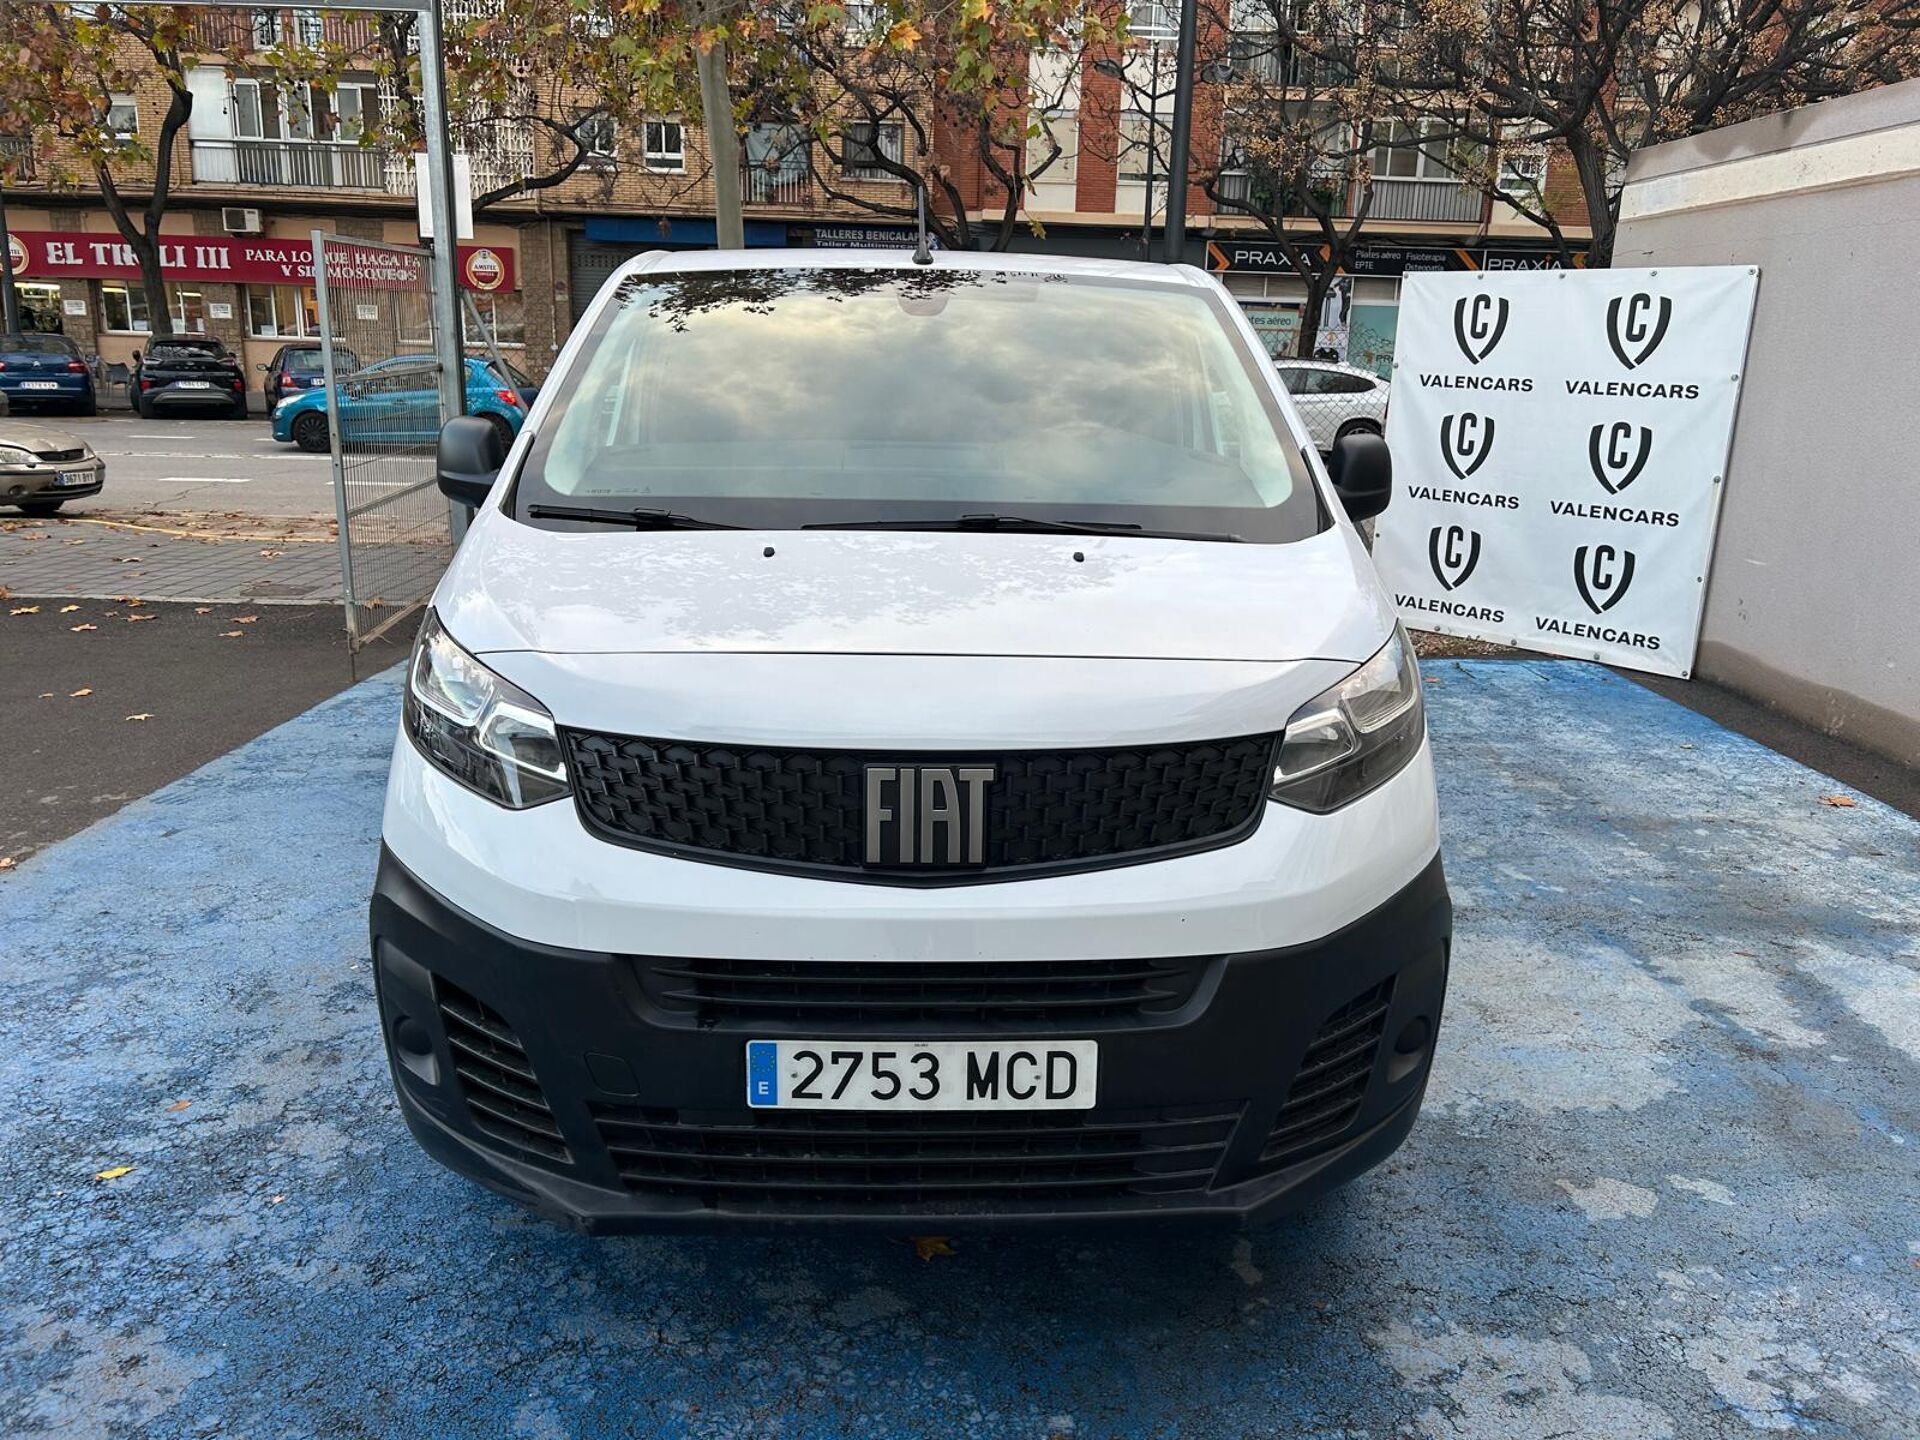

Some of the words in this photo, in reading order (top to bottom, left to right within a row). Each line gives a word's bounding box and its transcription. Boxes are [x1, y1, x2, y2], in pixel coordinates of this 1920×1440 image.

[816, 229, 864, 240] TALLERES
[46, 241, 83, 265] EL
[89, 242, 187, 268] TIRLI
[195, 246, 231, 269] III
[245, 249, 287, 262] PARA
[291, 250, 312, 263] LO
[281, 264, 292, 276] Y
[1419, 374, 1533, 392] VALENCARS
[1565, 380, 1700, 400] VALENCARS
[1408, 485, 1520, 510] VALENCARS
[1550, 500, 1680, 527] VALENCARS
[1394, 593, 1505, 624] VALENCARS
[1535, 616, 1661, 651] VALENCARS
[866, 767, 995, 864] FIAT
[758, 1081, 769, 1095] E
[791, 1050, 941, 1101] 2753
[966, 1050, 1078, 1101] MCD
